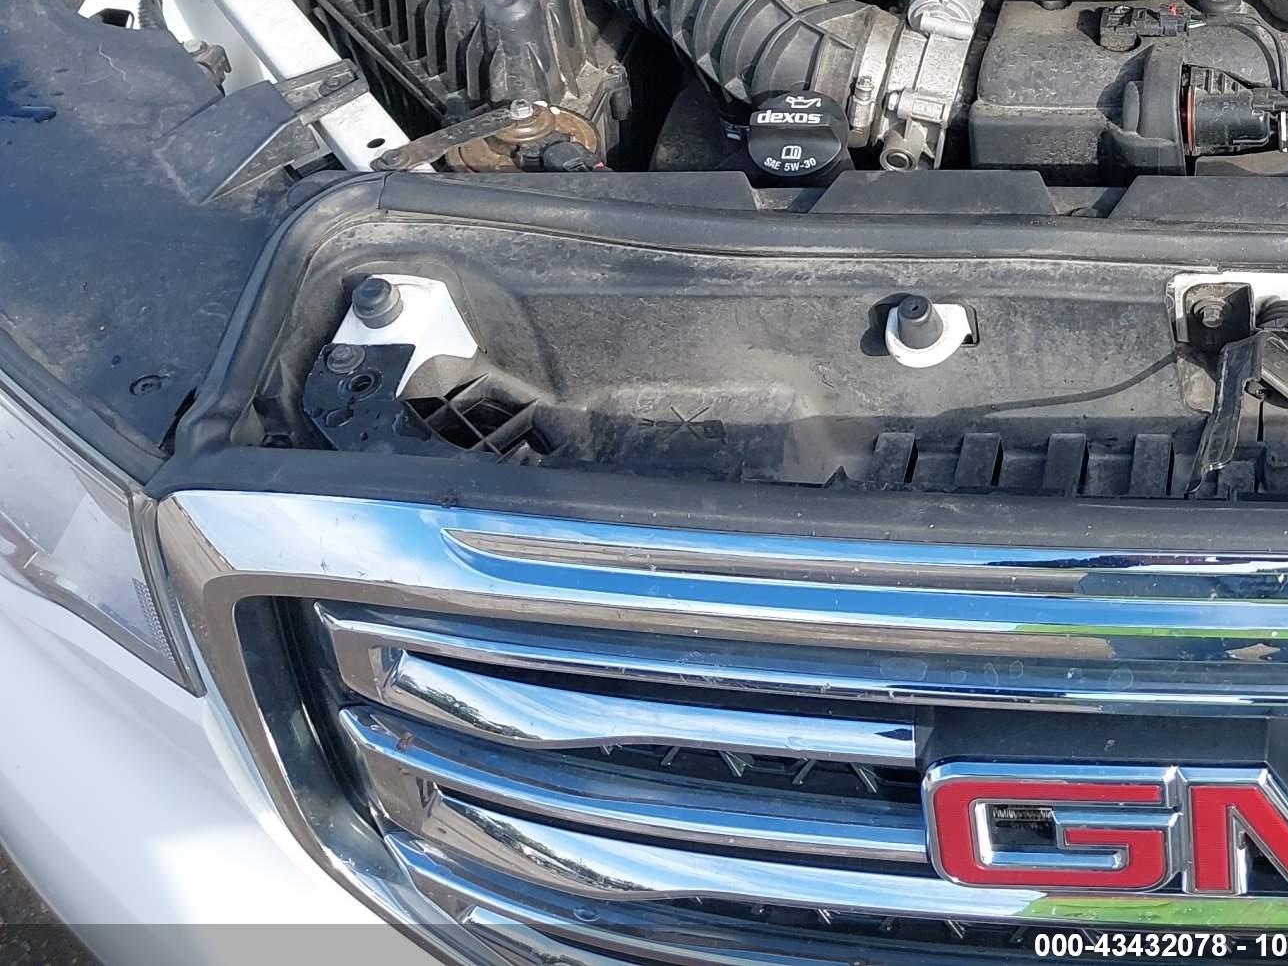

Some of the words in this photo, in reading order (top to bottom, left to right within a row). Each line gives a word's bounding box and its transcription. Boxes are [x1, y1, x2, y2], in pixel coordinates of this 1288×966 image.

[757, 110, 822, 124] dexos
[763, 157, 781, 170] SAE
[784, 157, 817, 171] 5W-30
